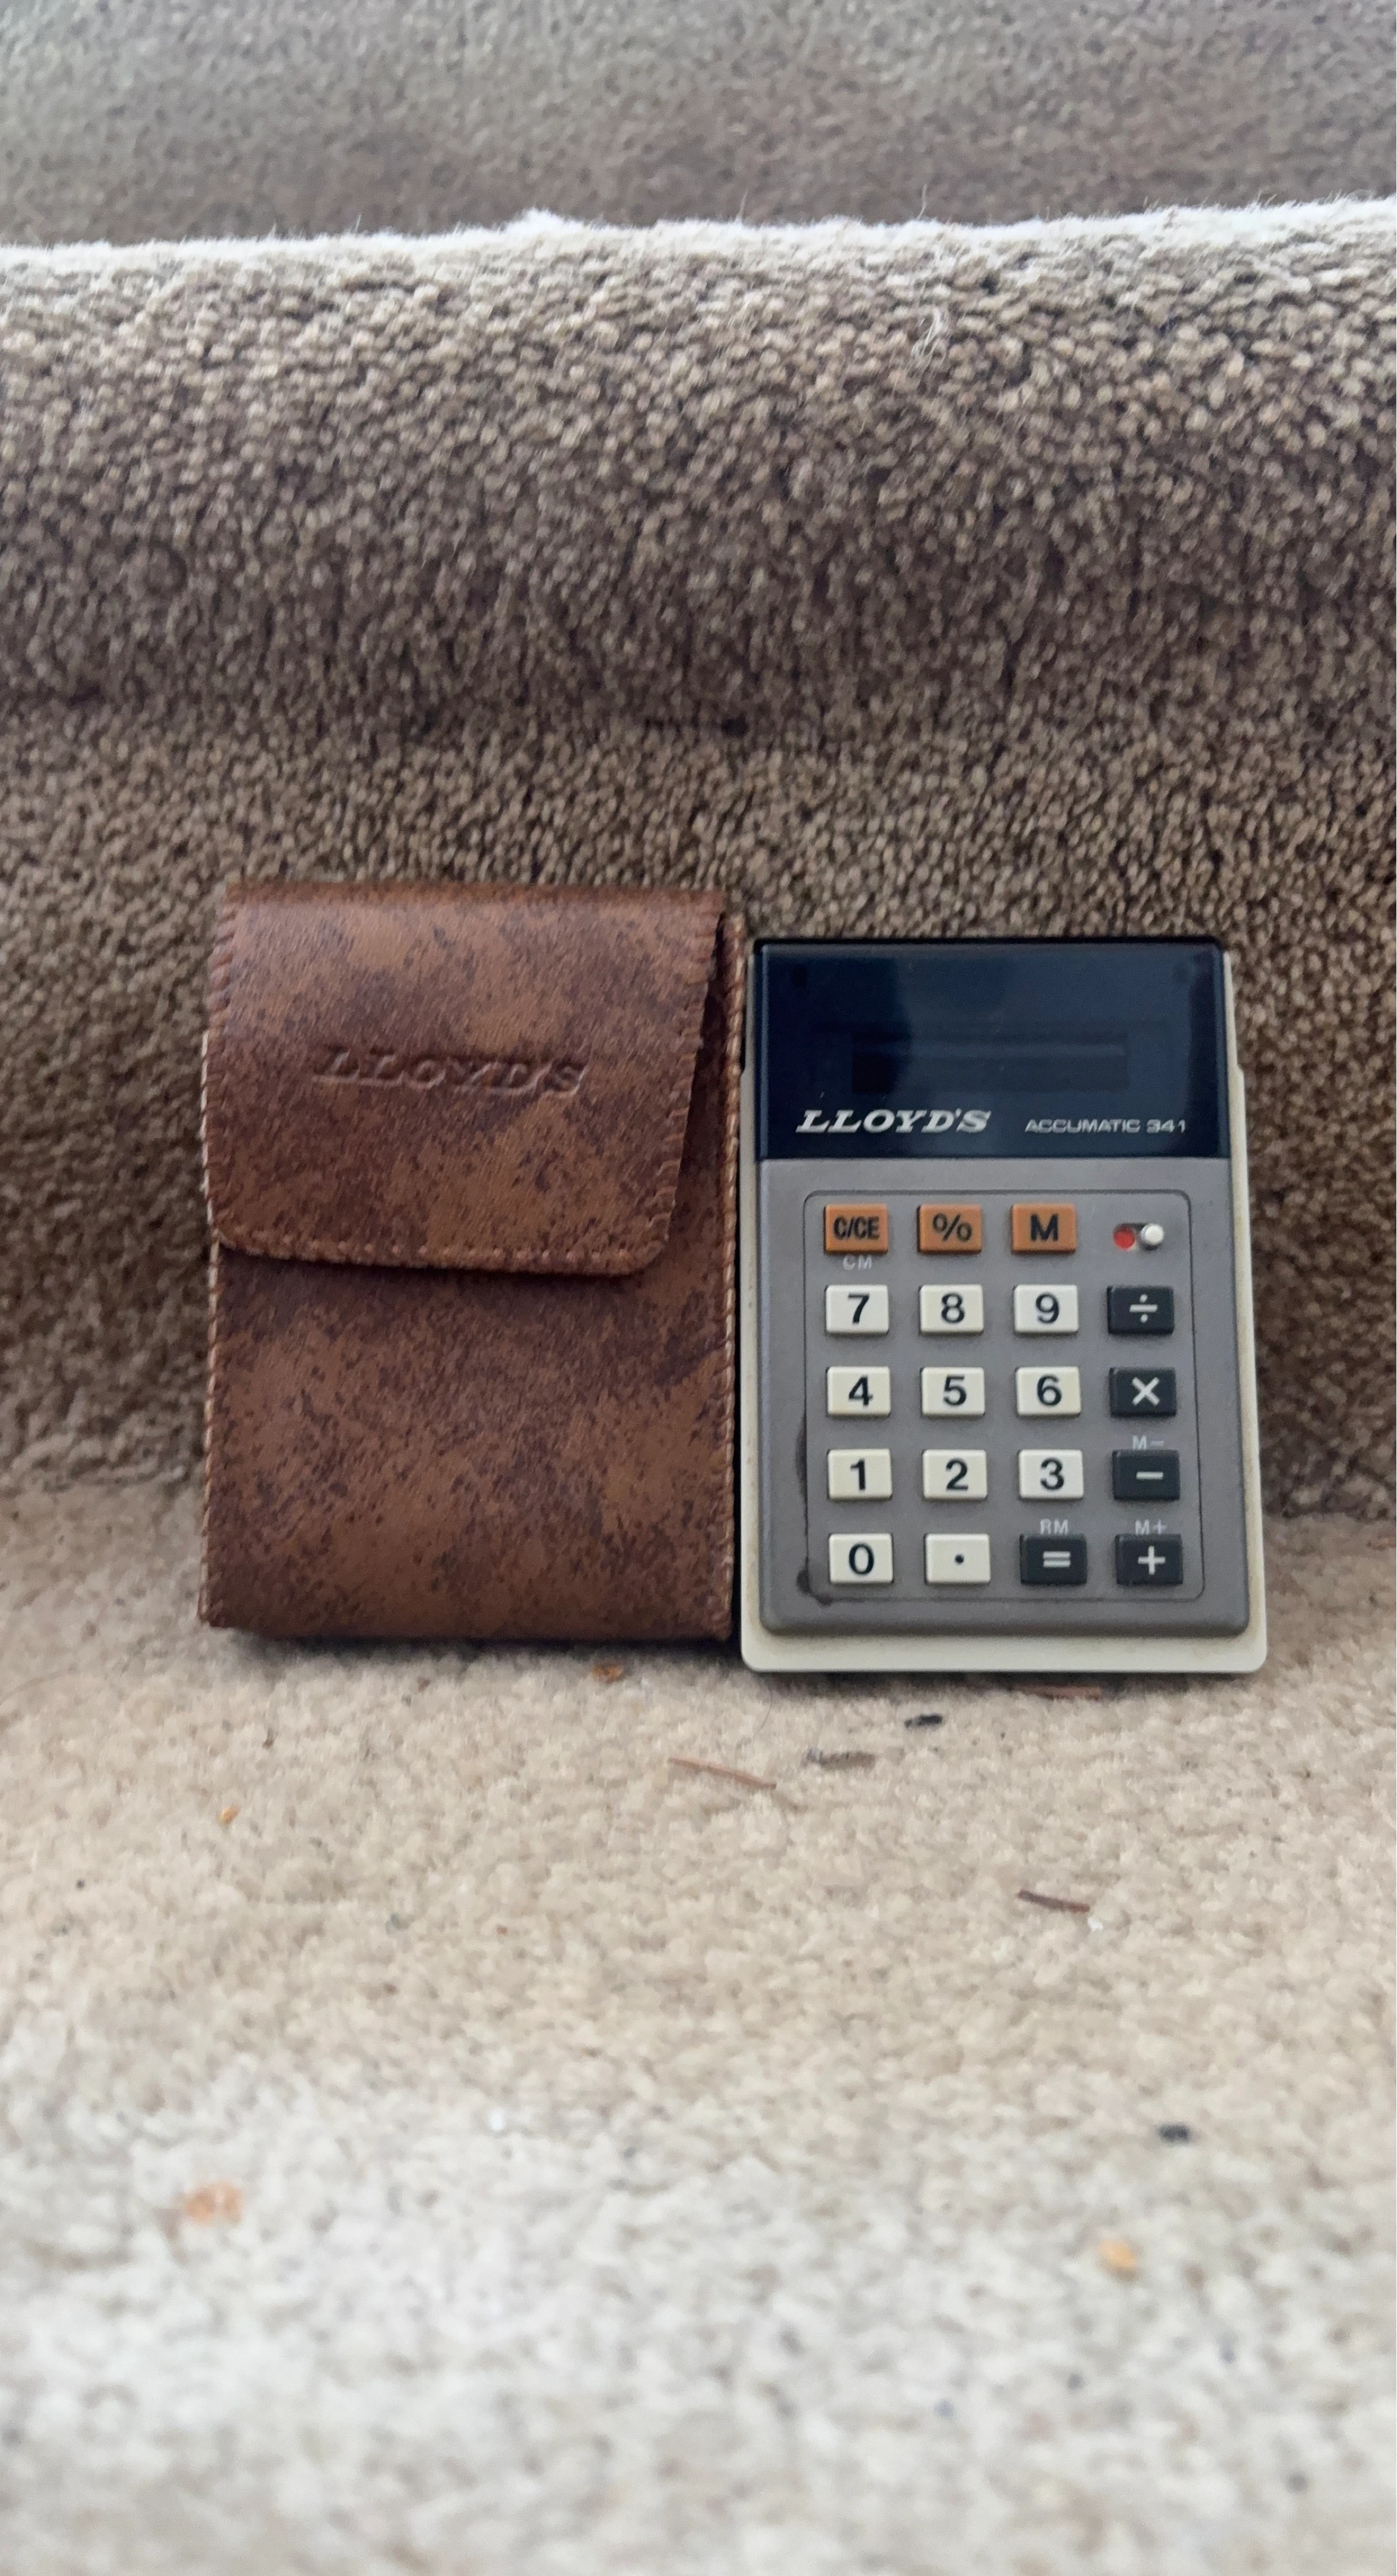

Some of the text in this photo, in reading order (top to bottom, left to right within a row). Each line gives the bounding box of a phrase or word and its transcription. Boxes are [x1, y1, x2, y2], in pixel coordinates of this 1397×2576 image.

[796, 1109, 991, 1134] LLOYD'S
[1024, 1119, 1185, 1133] ACCUMATIC 341
[834, 1216, 880, 1240] C/CE
[933, 1213, 972, 1241] %
[1030, 1214, 1058, 1241] M
[842, 1255, 872, 1270] CM
[847, 1293, 870, 1324] 7
[941, 1293, 965, 1324] 8
[1035, 1293, 1060, 1324] 9
[848, 1375, 872, 1405] 4
[943, 1375, 967, 1406] 5
[1037, 1375, 1062, 1406] 6
[850, 1459, 866, 1490] 1
[945, 1459, 968, 1490] 2
[1040, 1459, 1065, 1490] 3
[1040, 1520, 1068, 1533] RM
[848, 1543, 875, 1575] 0
